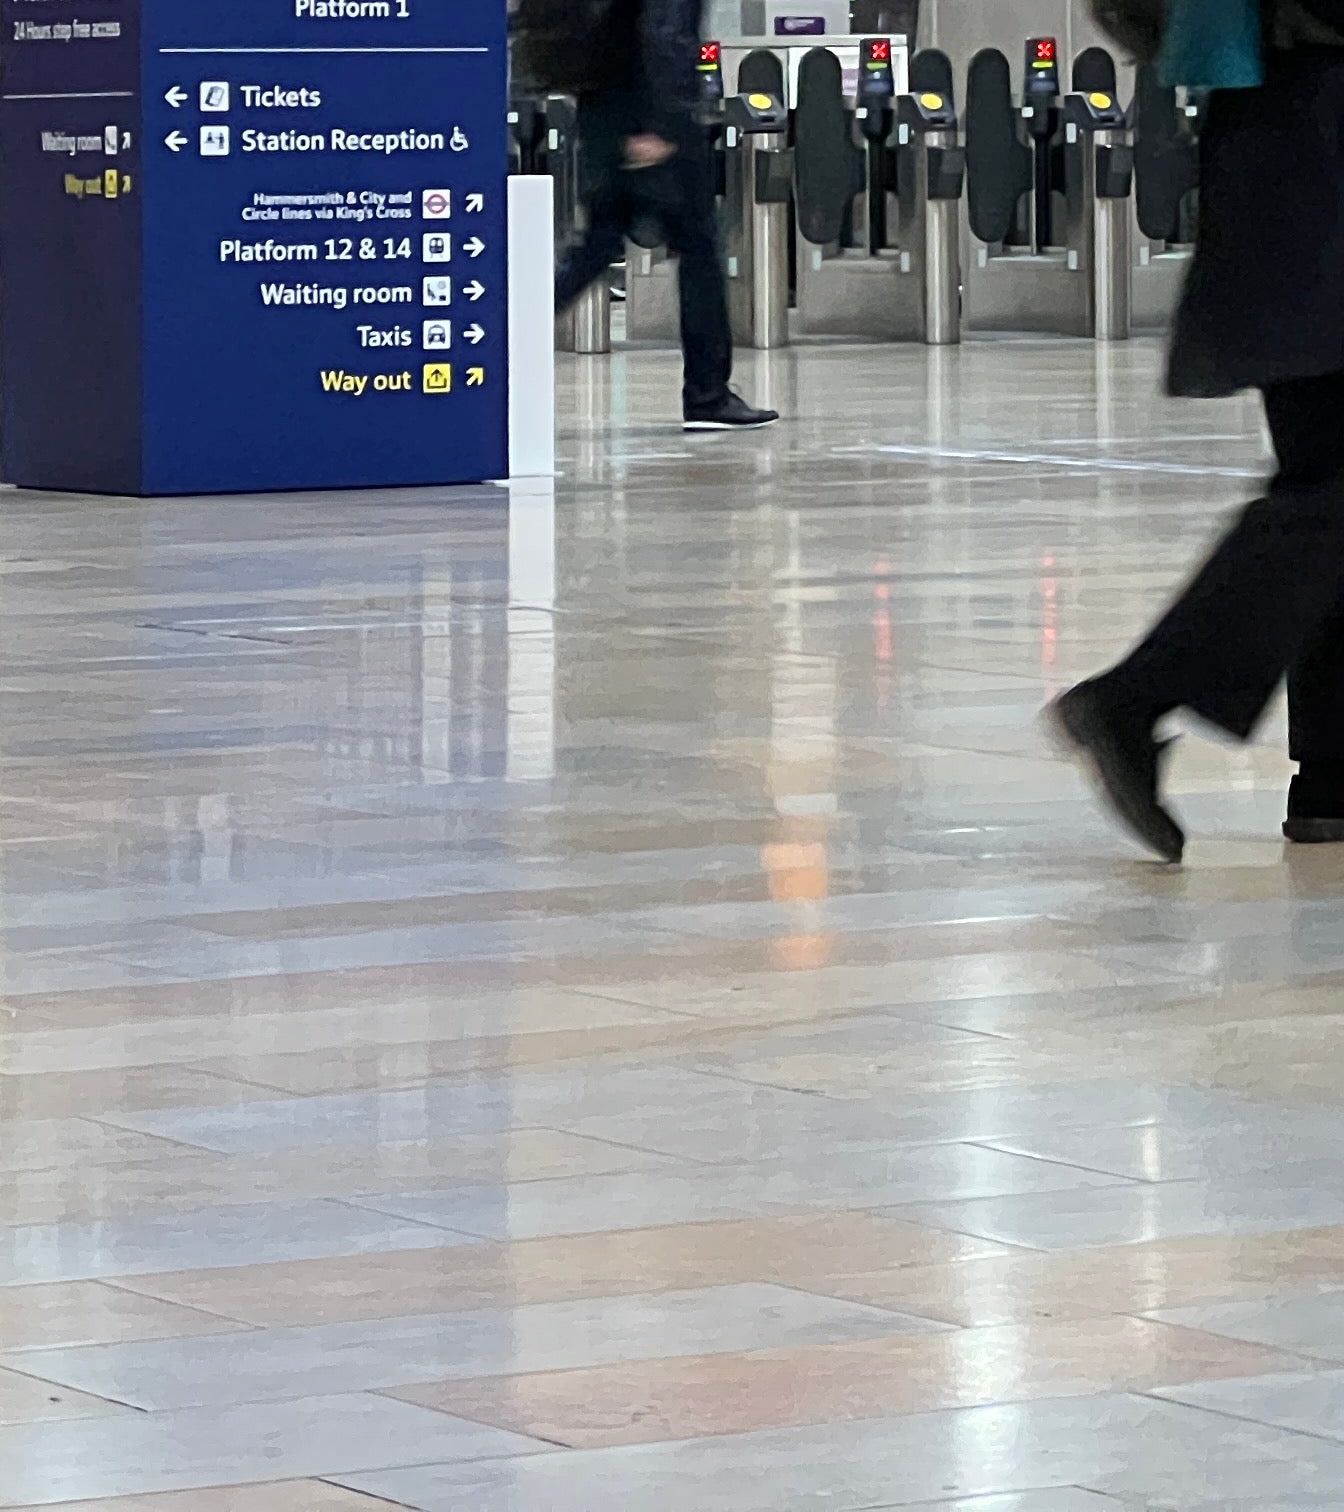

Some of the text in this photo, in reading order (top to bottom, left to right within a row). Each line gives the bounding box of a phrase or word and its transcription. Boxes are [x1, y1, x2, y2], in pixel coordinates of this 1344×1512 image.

[240, 85, 321, 108] Tickets
[242, 129, 443, 154] Station Reception
[346, 192, 357, 204] &
[360, 191, 386, 208] City
[389, 191, 412, 204] and
[242, 205, 411, 221] Circle lines via King's Cross
[220, 238, 412, 262] Platform 12 & 14
[260, 284, 412, 309] Waiting room
[357, 325, 412, 347] Taxis
[321, 370, 411, 395] Way out
